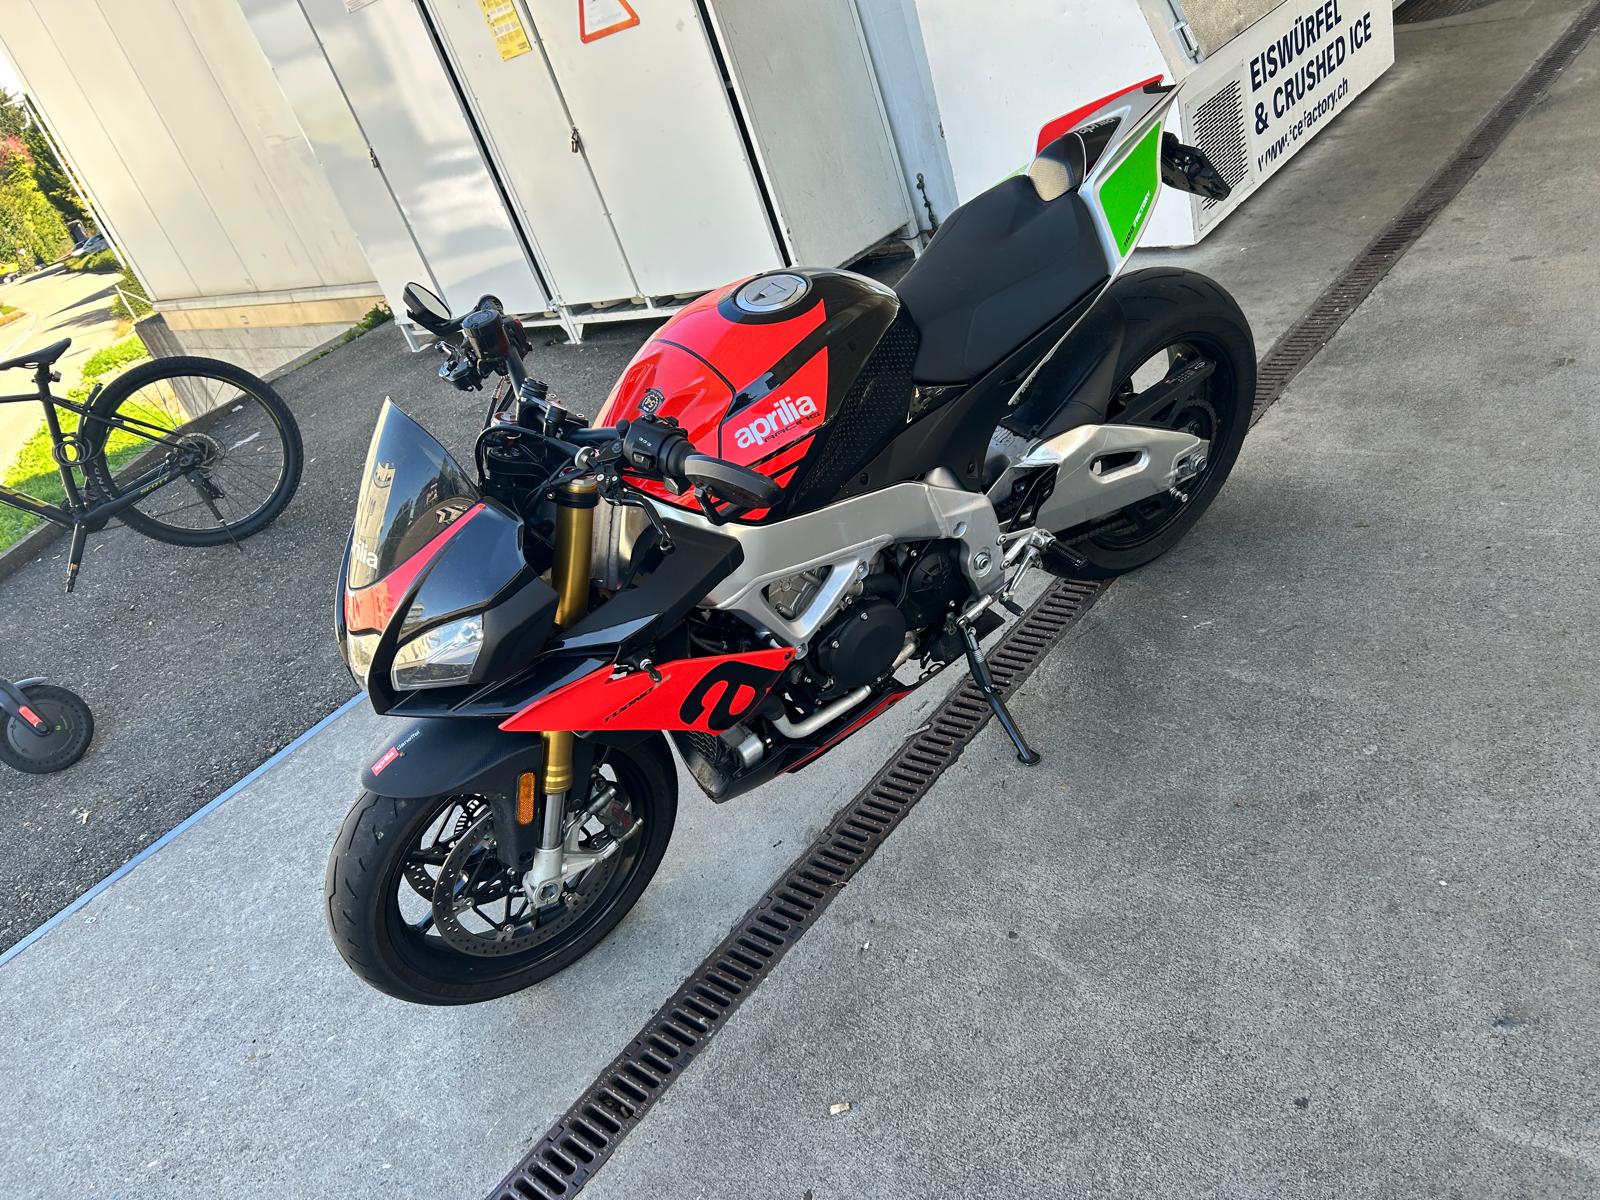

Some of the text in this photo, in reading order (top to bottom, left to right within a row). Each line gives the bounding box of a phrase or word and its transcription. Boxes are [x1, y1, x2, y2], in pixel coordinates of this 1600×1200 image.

[1250, 0, 1341, 92] EISWÜRFEL
[1255, 11, 1371, 135] & CRUSHED ICE
[735, 396, 817, 448] aprilia
